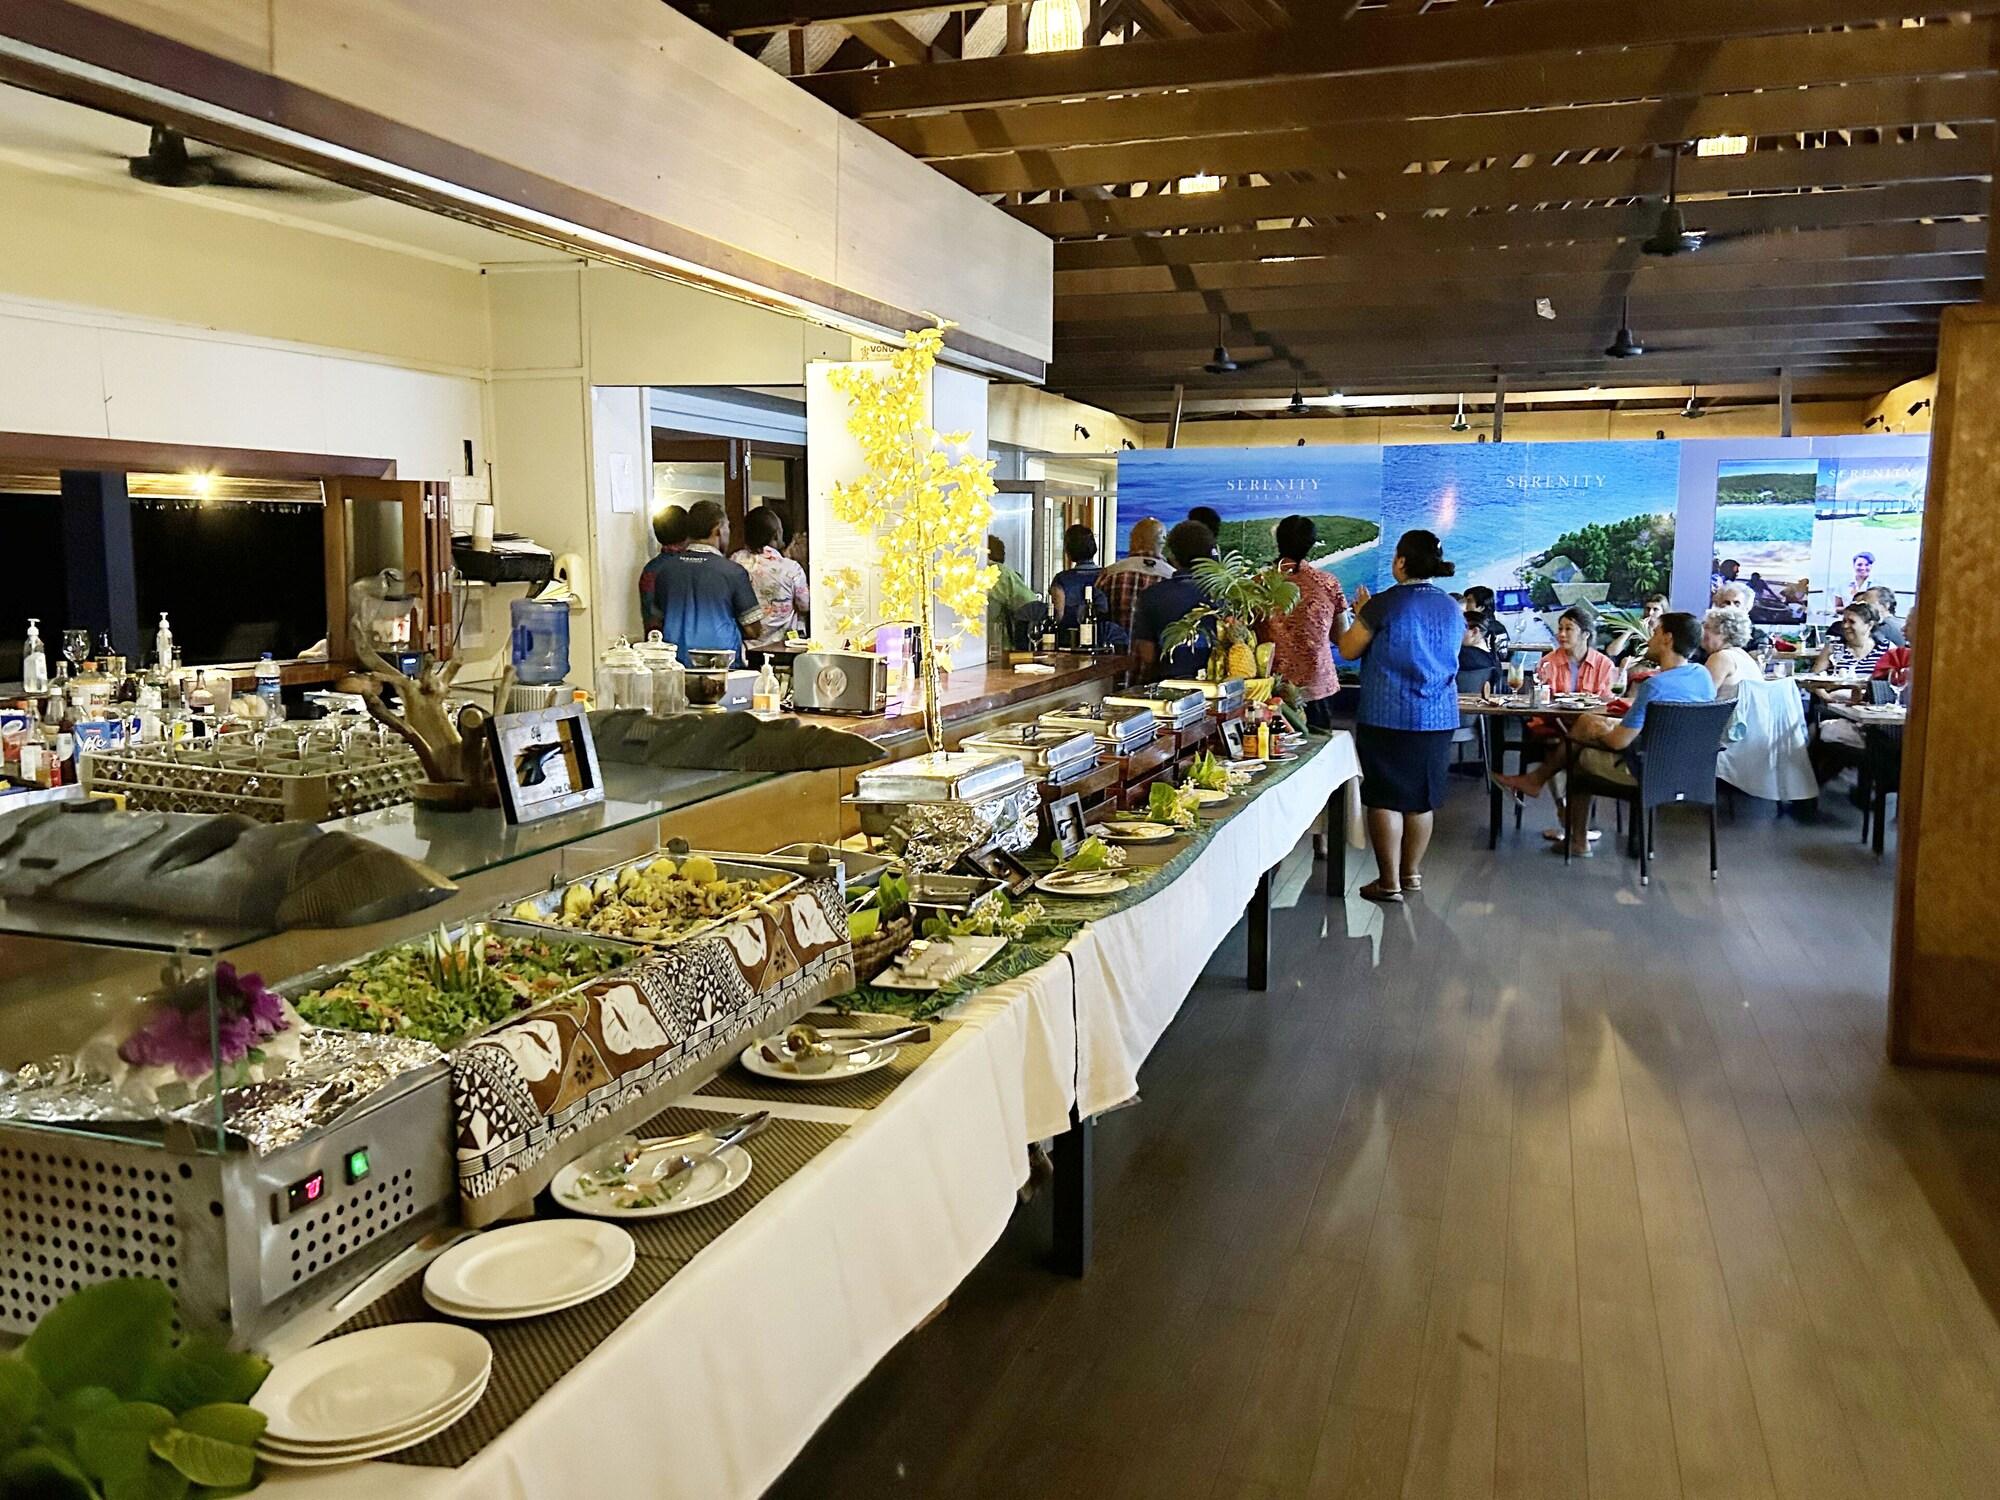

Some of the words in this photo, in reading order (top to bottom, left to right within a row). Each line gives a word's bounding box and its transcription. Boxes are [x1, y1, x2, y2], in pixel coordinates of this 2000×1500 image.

[1828, 468, 1914, 479] SERENITY
[1226, 478, 1320, 491] SERENITY
[1505, 474, 1607, 489] SERENITY
